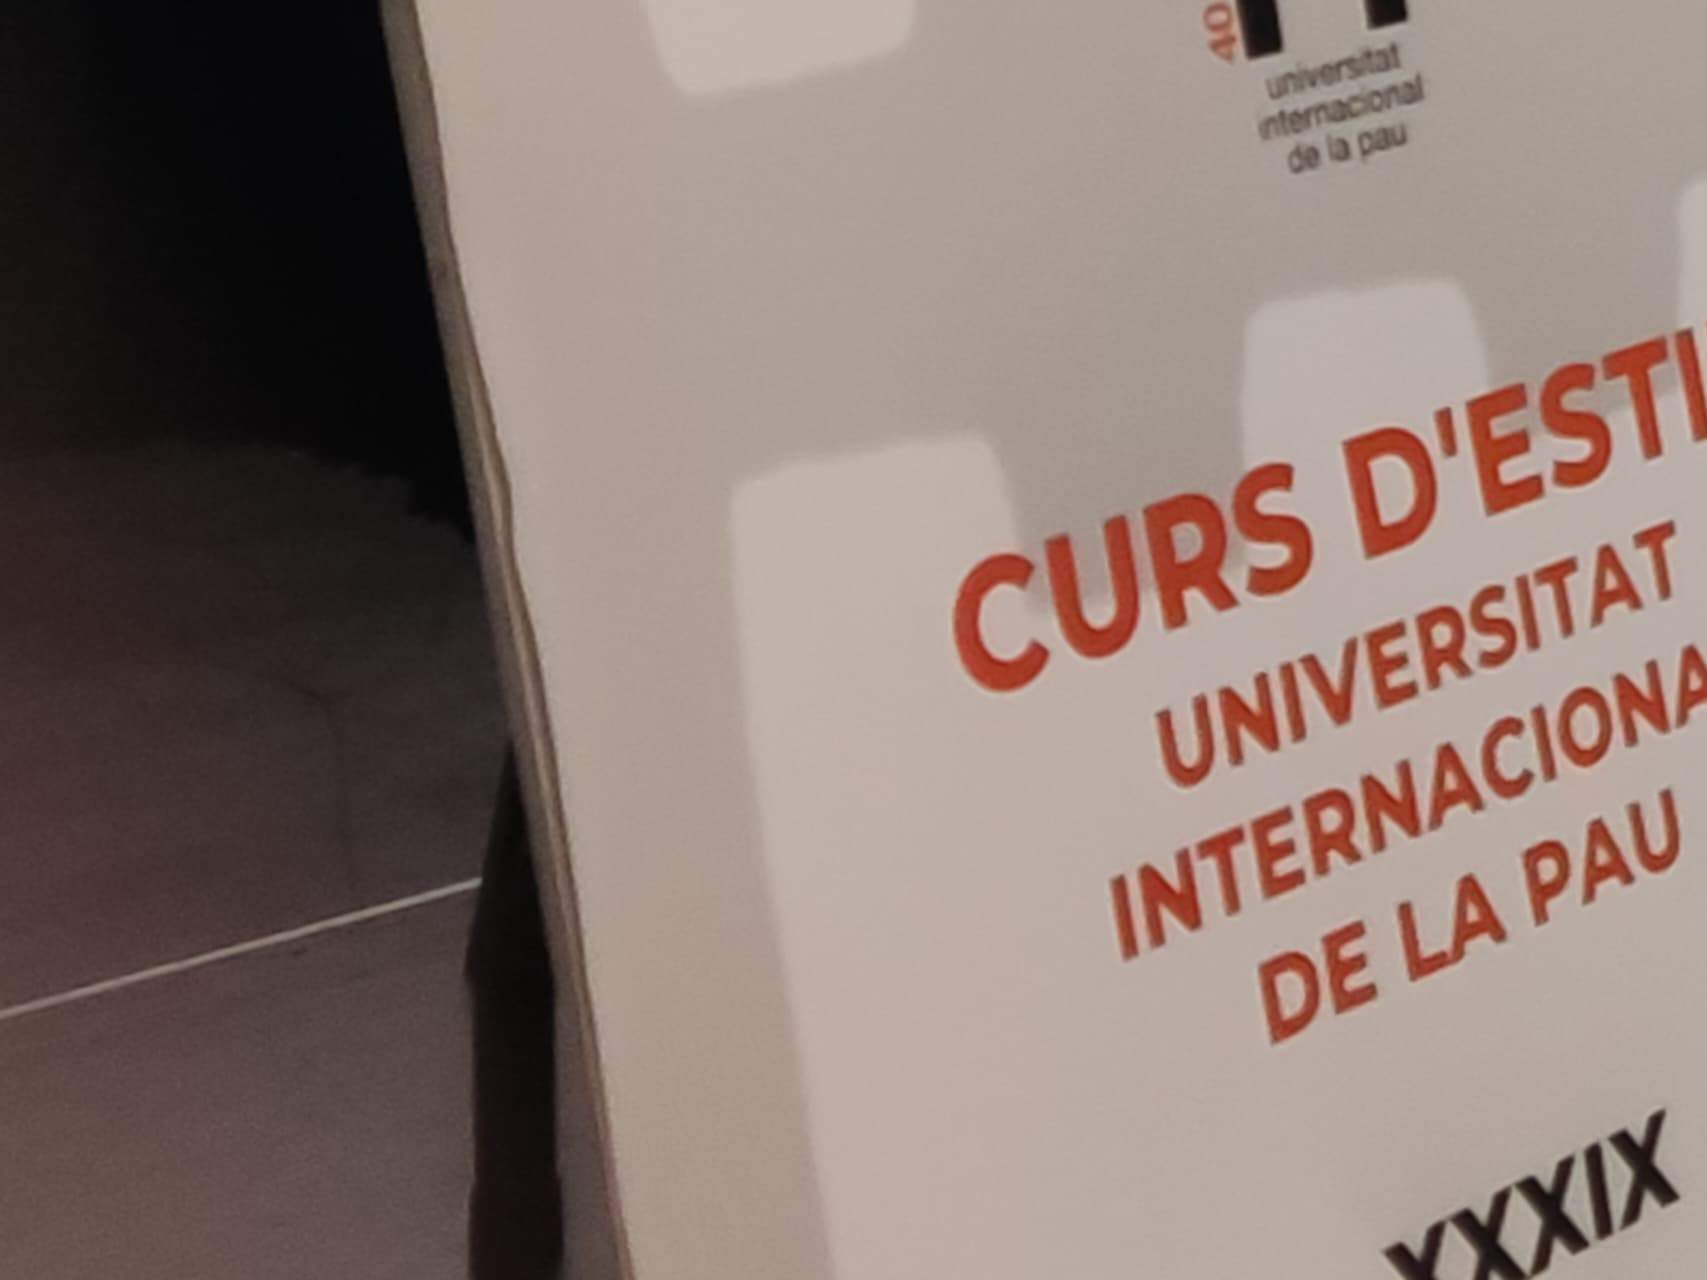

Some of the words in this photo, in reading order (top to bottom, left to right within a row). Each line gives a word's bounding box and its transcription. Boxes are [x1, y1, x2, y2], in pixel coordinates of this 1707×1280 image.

[1203, 2, 1238, 64] 40
[1265, 42, 1402, 100] universitat
[1257, 72, 1426, 140] internacional
[1287, 146, 1321, 174] de
[1327, 135, 1351, 162] la
[1358, 124, 1409, 162] pau
[953, 463, 1313, 692] CURS
[1156, 521, 1677, 788] UNIVERSITAT
[1258, 922, 1378, 1044] DE
[1398, 875, 1508, 982] LA
[1522, 789, 1682, 926] PAU
[1382, 1108, 1680, 1280] XXXIX
